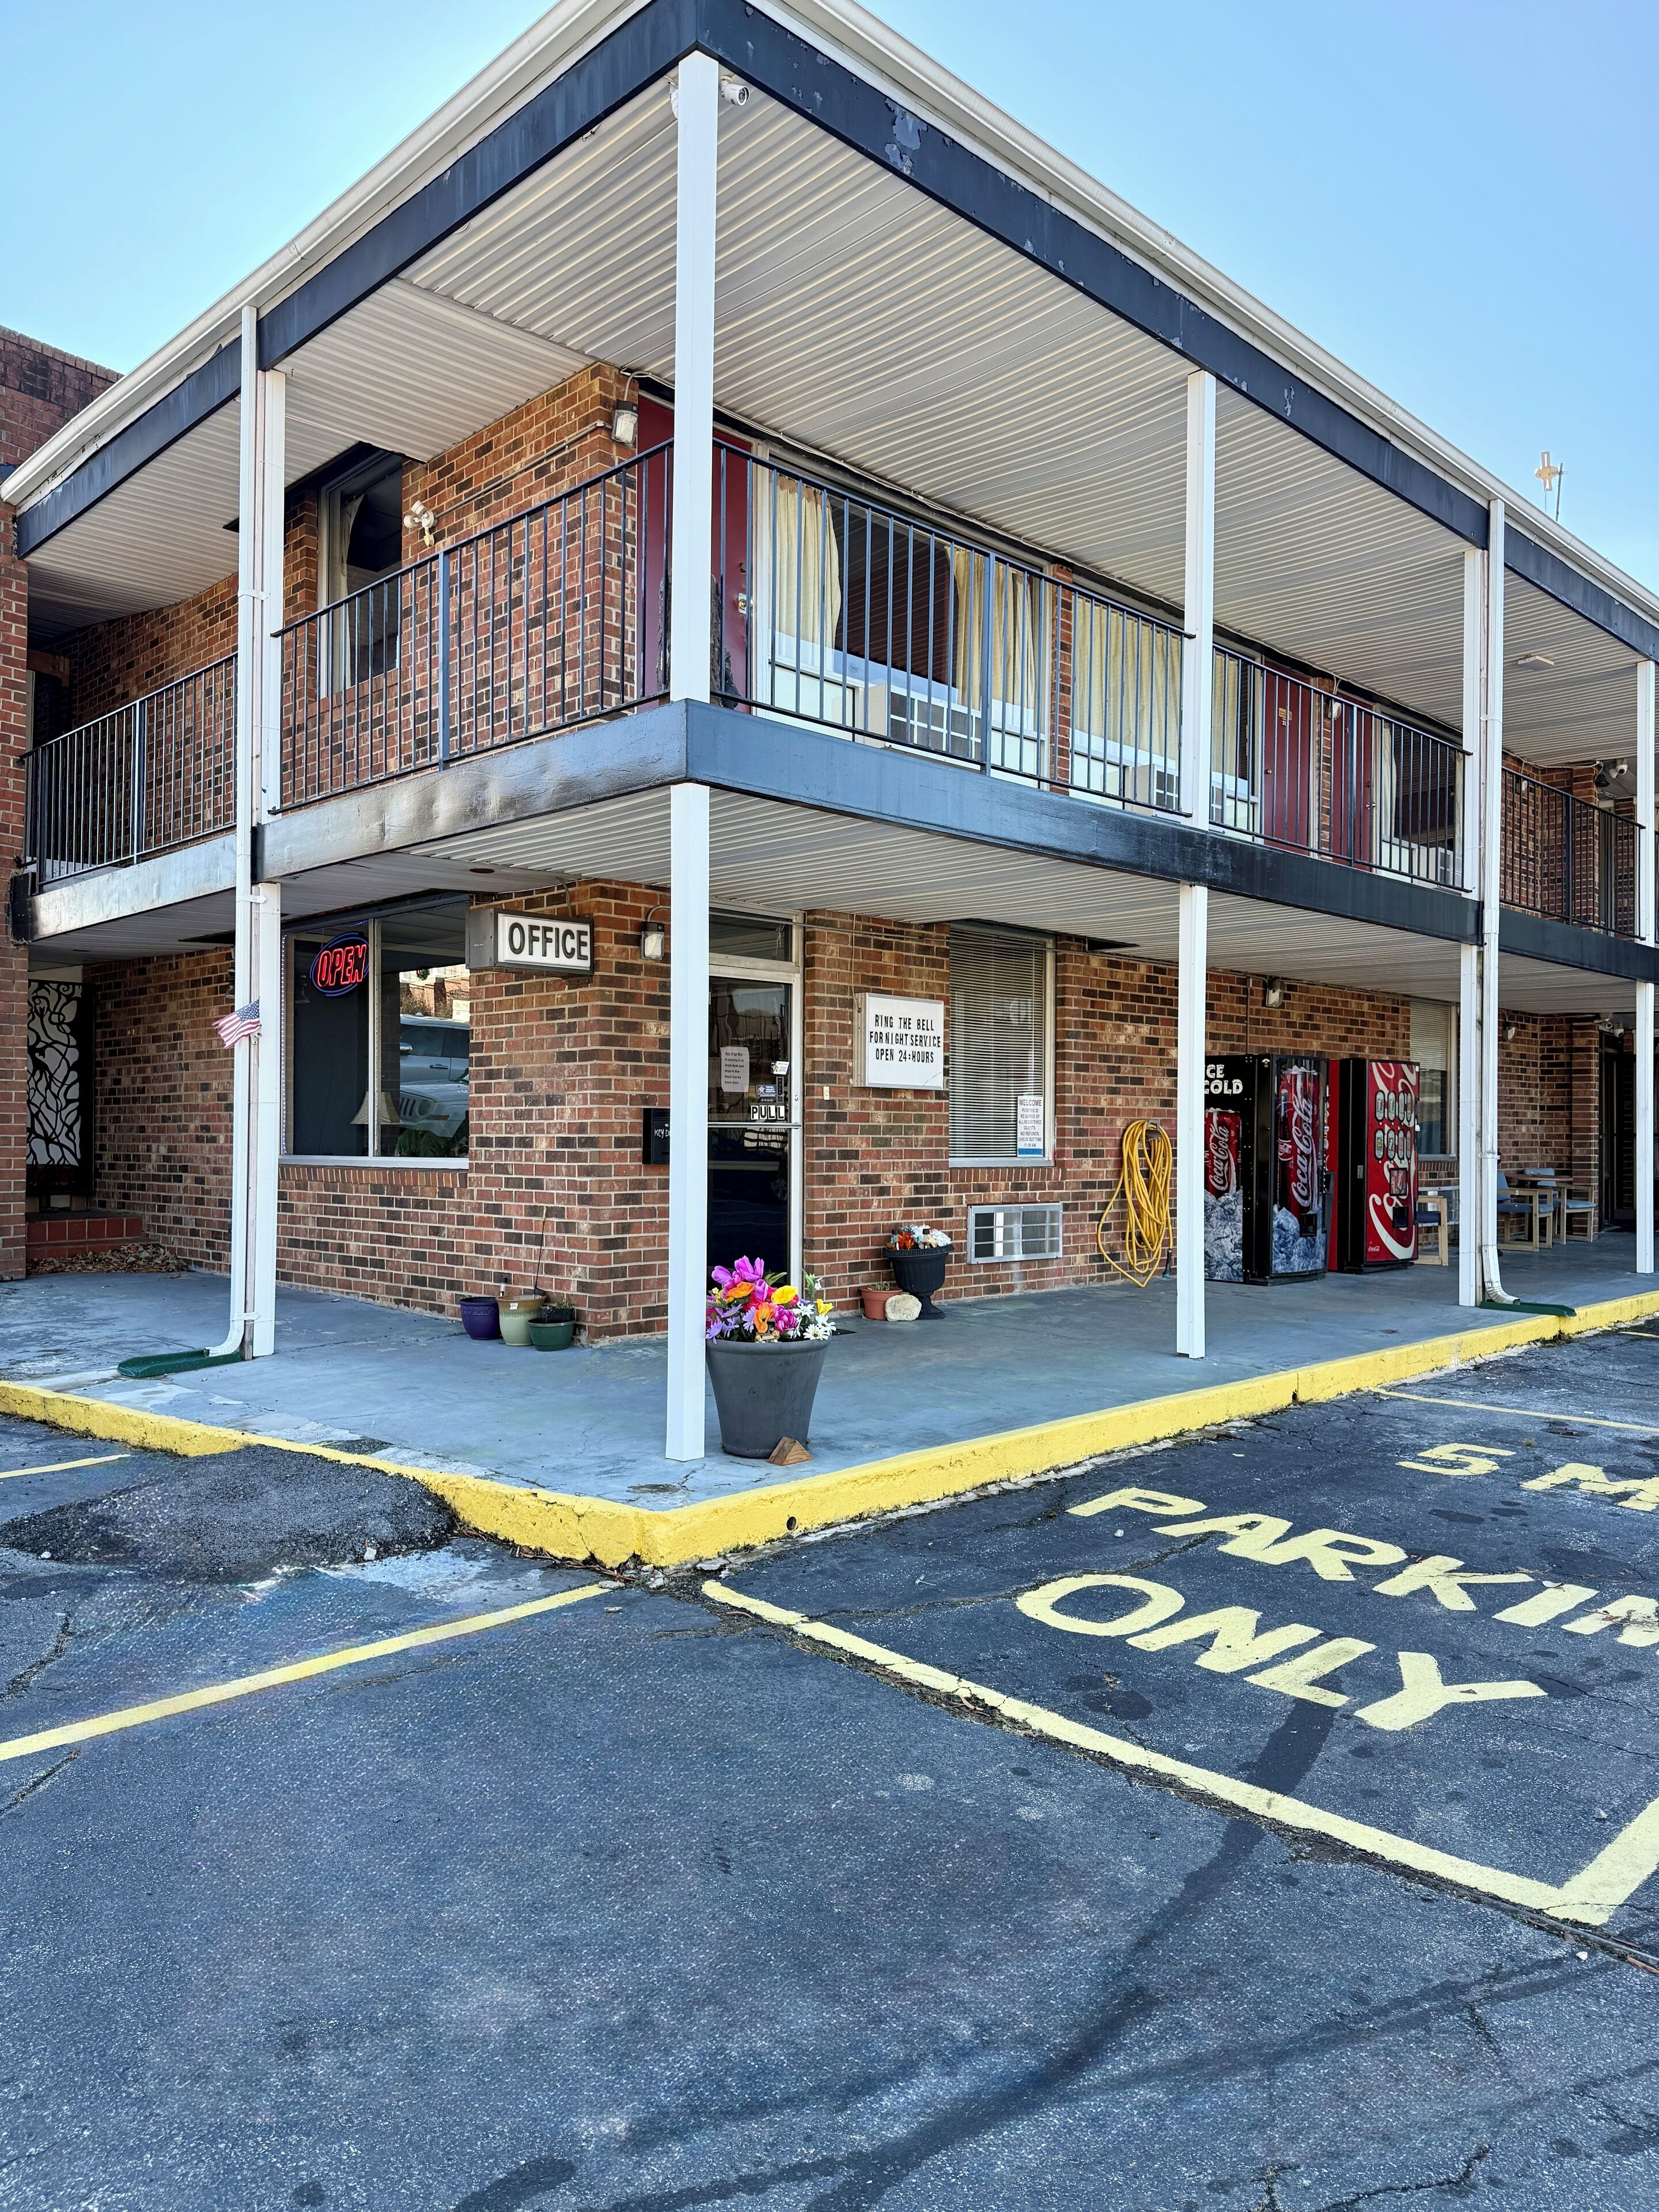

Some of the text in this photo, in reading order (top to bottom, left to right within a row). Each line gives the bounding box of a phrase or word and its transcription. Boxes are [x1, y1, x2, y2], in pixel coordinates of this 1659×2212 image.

[508, 922, 588, 960] OFFICE
[317, 944, 367, 987] OPEN
[875, 1014, 934, 1031] RING THE BELL
[870, 1031, 941, 1047] FOR NIGHT SERVICE
[876, 1048, 894, 1060] OPEN
[1205, 1064, 1225, 1079] CE
[752, 1106, 785, 1119] PULL
[1291, 1094, 1313, 1207] Coca-Cola
[1395, 1442, 1517, 1476] 5
[1016, 1573, 1547, 1732] ONLY
